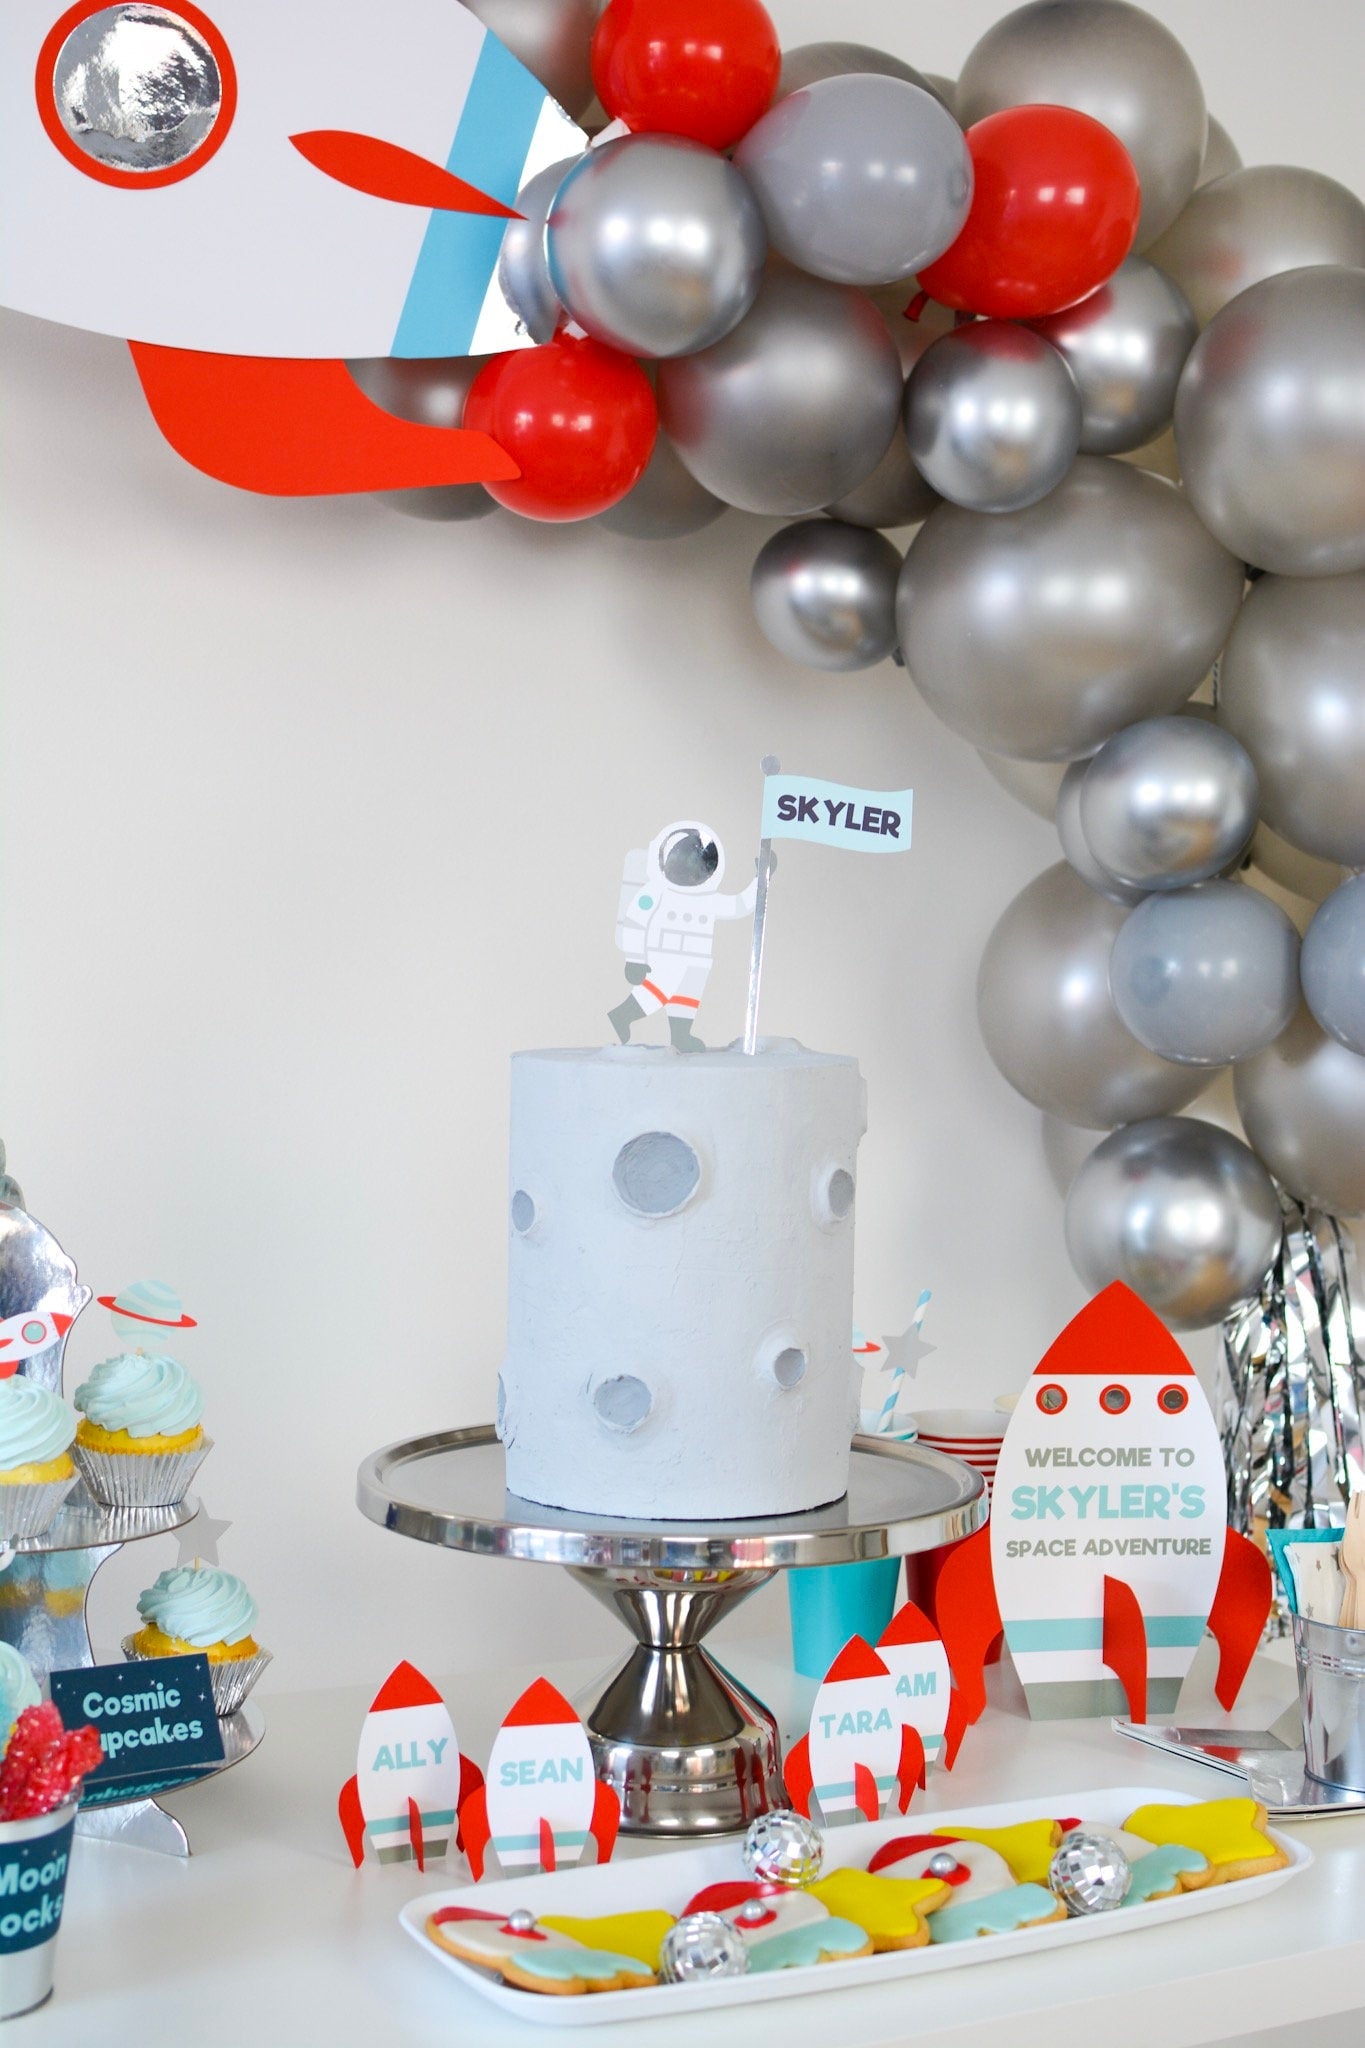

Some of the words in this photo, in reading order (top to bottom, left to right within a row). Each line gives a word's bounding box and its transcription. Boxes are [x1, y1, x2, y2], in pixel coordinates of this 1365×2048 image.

[777, 794, 901, 839] SKYLER
[1025, 1447, 1152, 1468] WELCOME
[1159, 1448, 1195, 1467] TO
[1010, 1483, 1206, 1521] SKYLER'S
[1006, 1539, 1077, 1558] SPACE
[1083, 1538, 1212, 1556] ADVENTURE
[82, 1682, 181, 1718] Cosmic
[895, 1671, 937, 1698] AM
[819, 1708, 893, 1739] TARA
[372, 1737, 449, 1771] ALLY
[500, 1757, 583, 1787] SEAN
[0, 1893, 63, 1938] ocks
